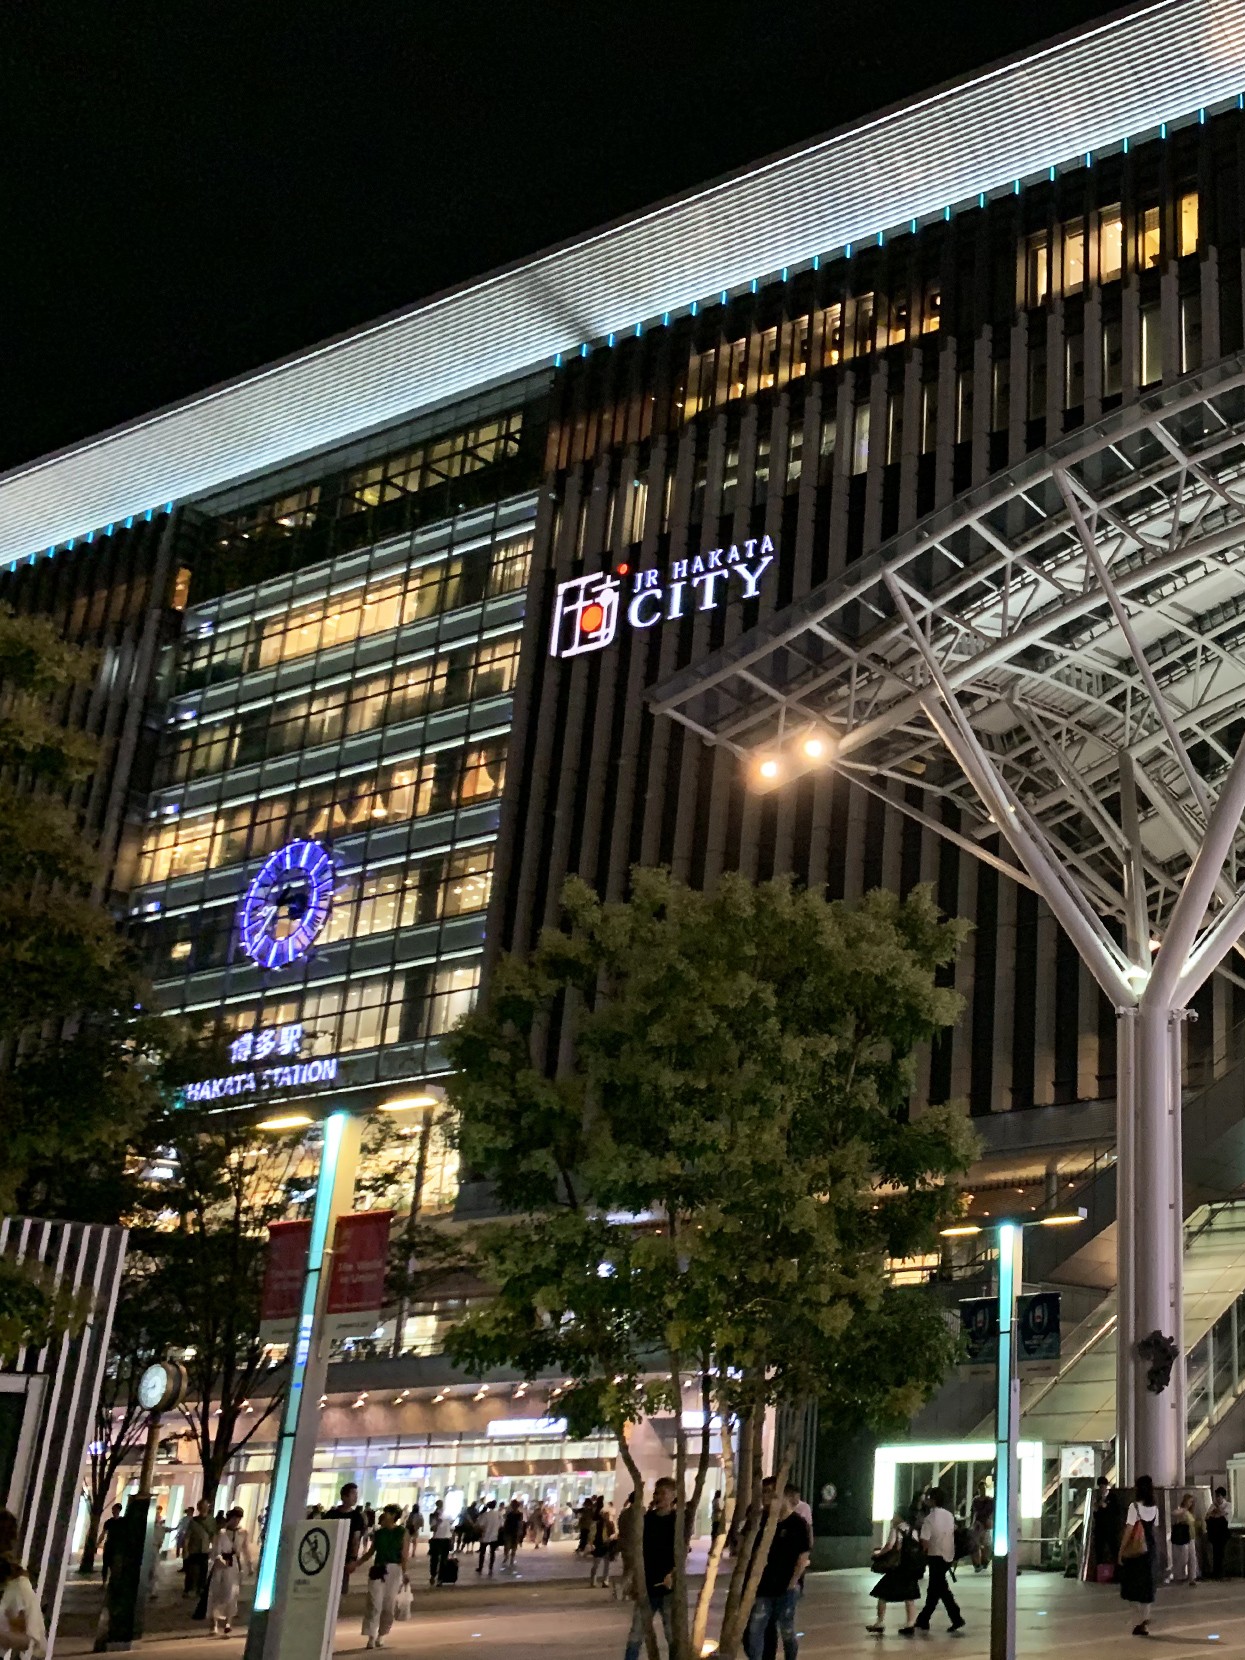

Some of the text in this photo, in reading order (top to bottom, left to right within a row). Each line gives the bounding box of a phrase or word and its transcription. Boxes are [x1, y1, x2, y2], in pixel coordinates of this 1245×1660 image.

[627, 555, 774, 628] CITY
[633, 534, 775, 593] JR HAKATA
[186, 1072, 256, 1101] HAKATA
